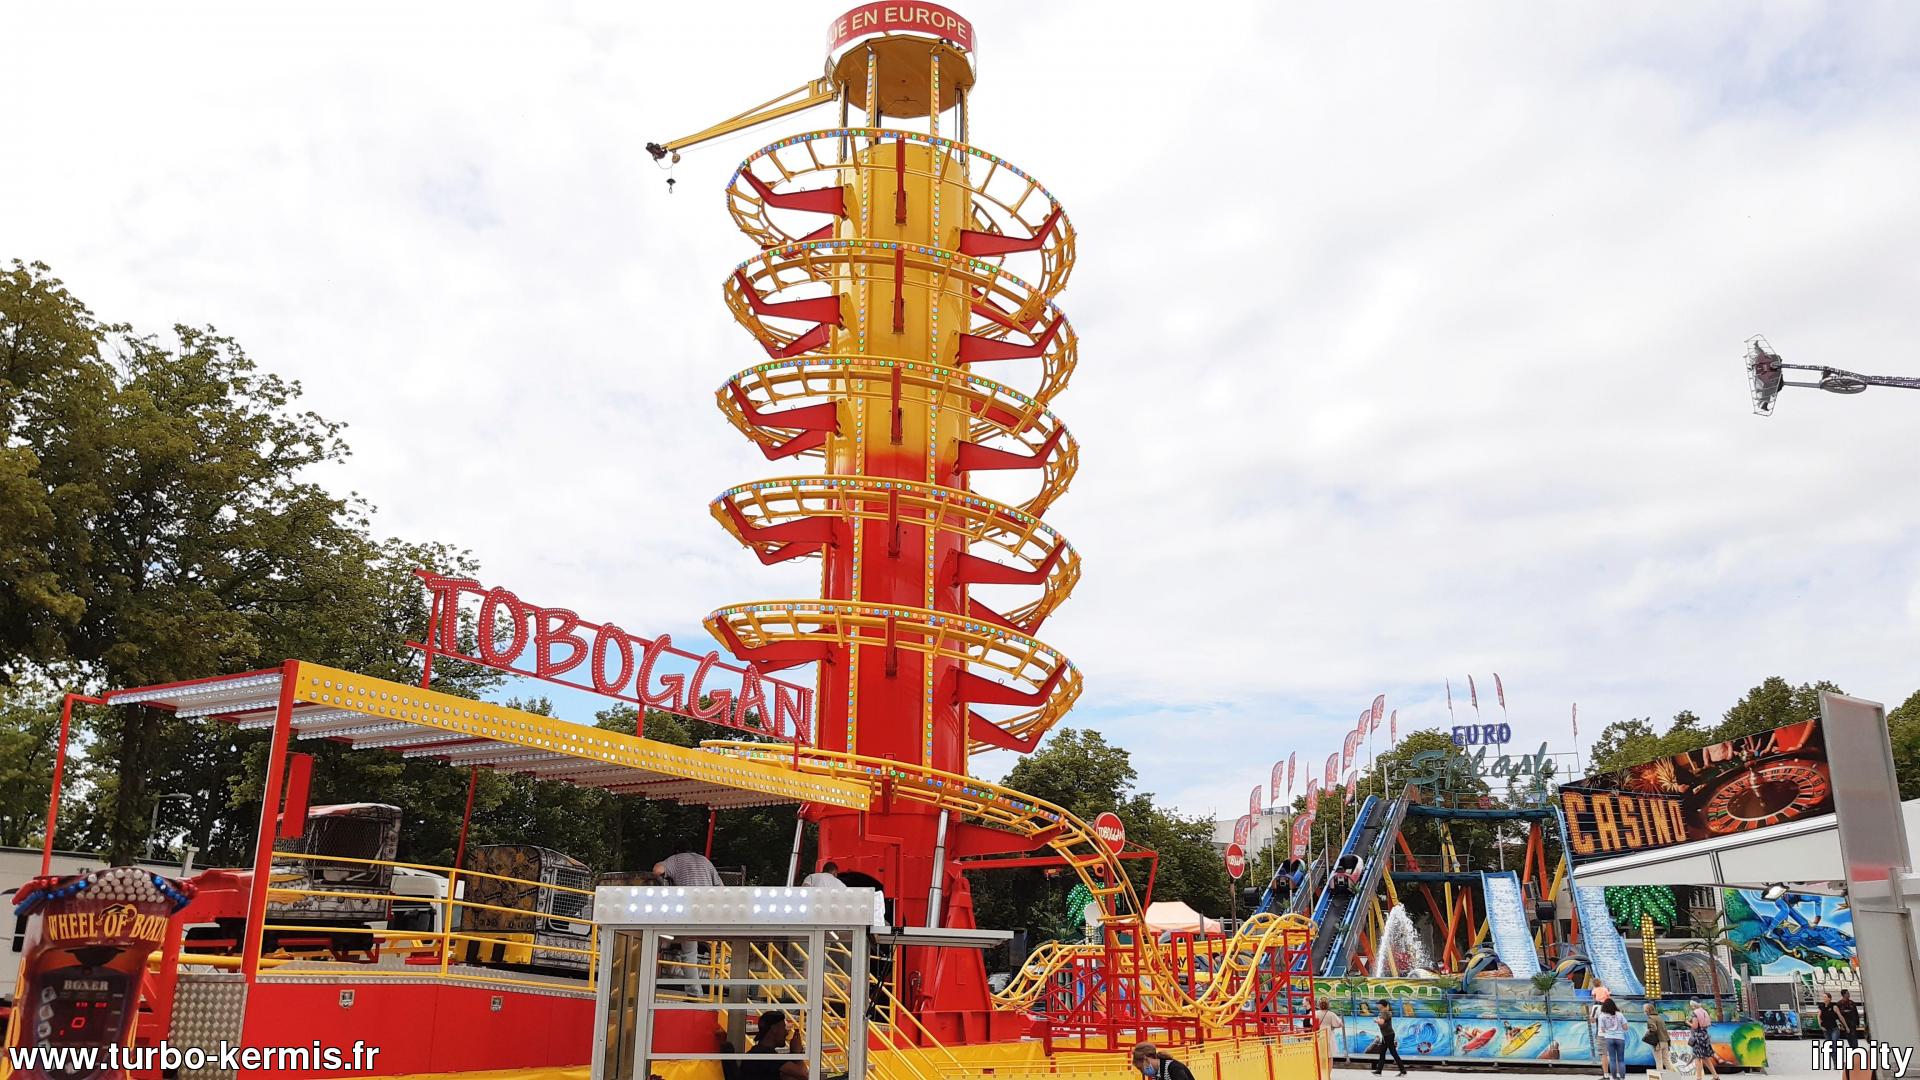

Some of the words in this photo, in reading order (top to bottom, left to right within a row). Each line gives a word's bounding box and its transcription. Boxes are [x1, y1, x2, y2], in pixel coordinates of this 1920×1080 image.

[852, 9, 878, 31] EN
[884, 6, 967, 40] EUROPE
[426, 576, 813, 746] TOBOGGAN
[1452, 723, 1511, 746] EURO
[1408, 742, 1558, 790] Splash
[1562, 791, 1687, 855] CASINO
[48, 913, 98, 941] WHEEL
[103, 914, 128, 938] OF
[64, 979, 109, 991] BOXER
